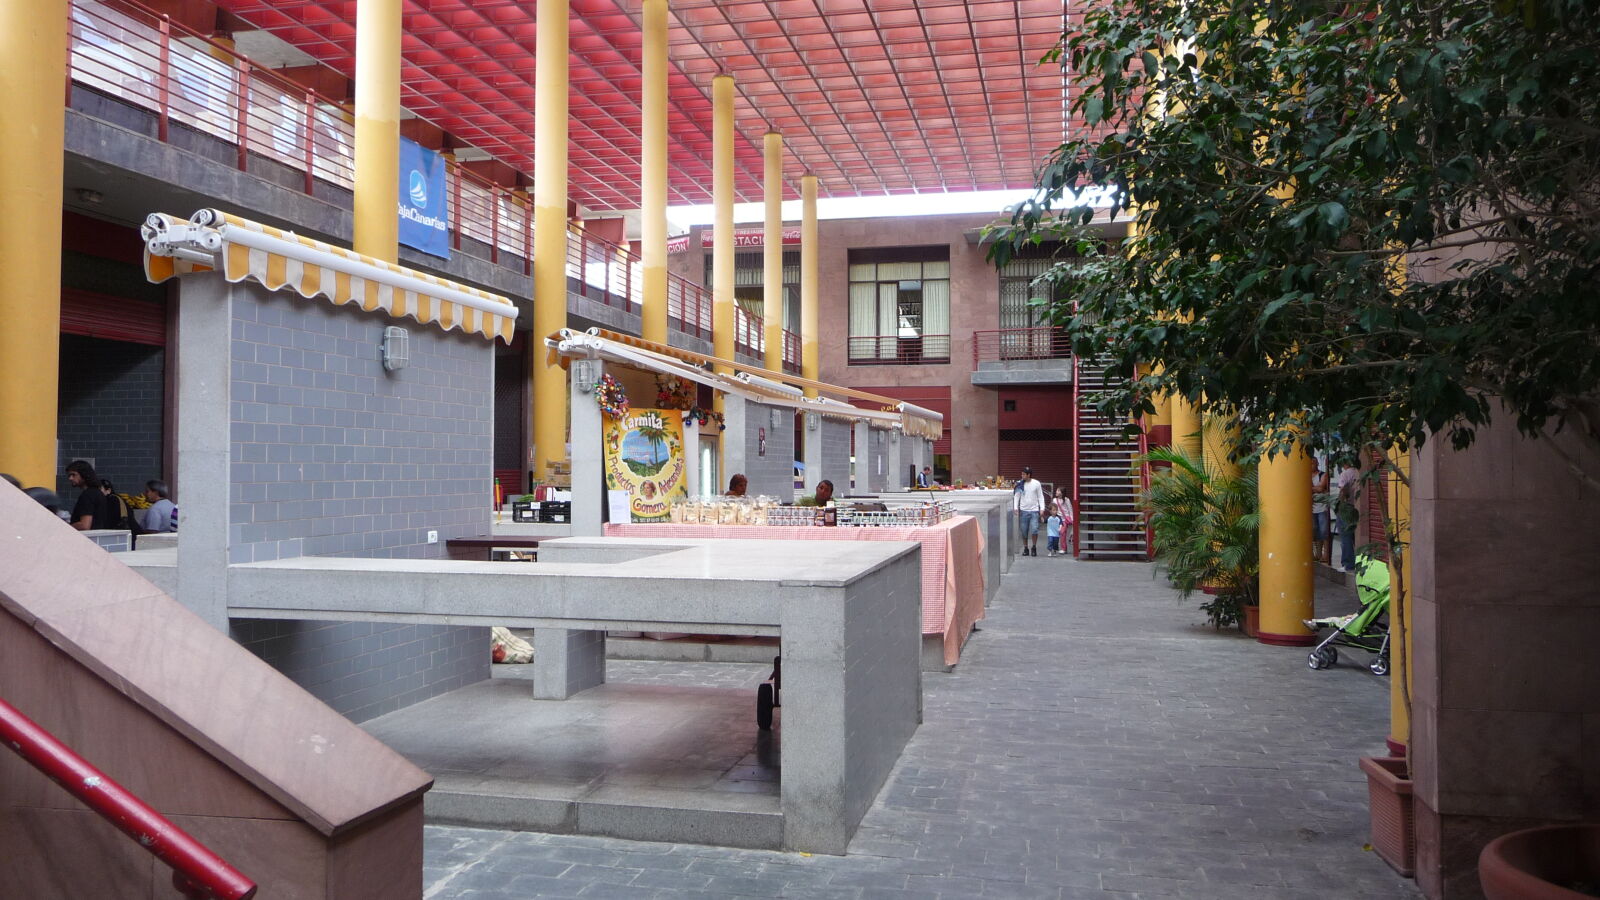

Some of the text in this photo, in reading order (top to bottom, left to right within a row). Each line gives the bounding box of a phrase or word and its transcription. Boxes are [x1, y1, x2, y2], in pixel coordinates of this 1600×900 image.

[398, 202, 446, 231] ajaCanarias
[667, 242, 687, 254] CIÓN
[734, 235, 764, 247] STACI
[621, 412, 664, 431] Carmita
[608, 455, 636, 496] Productos
